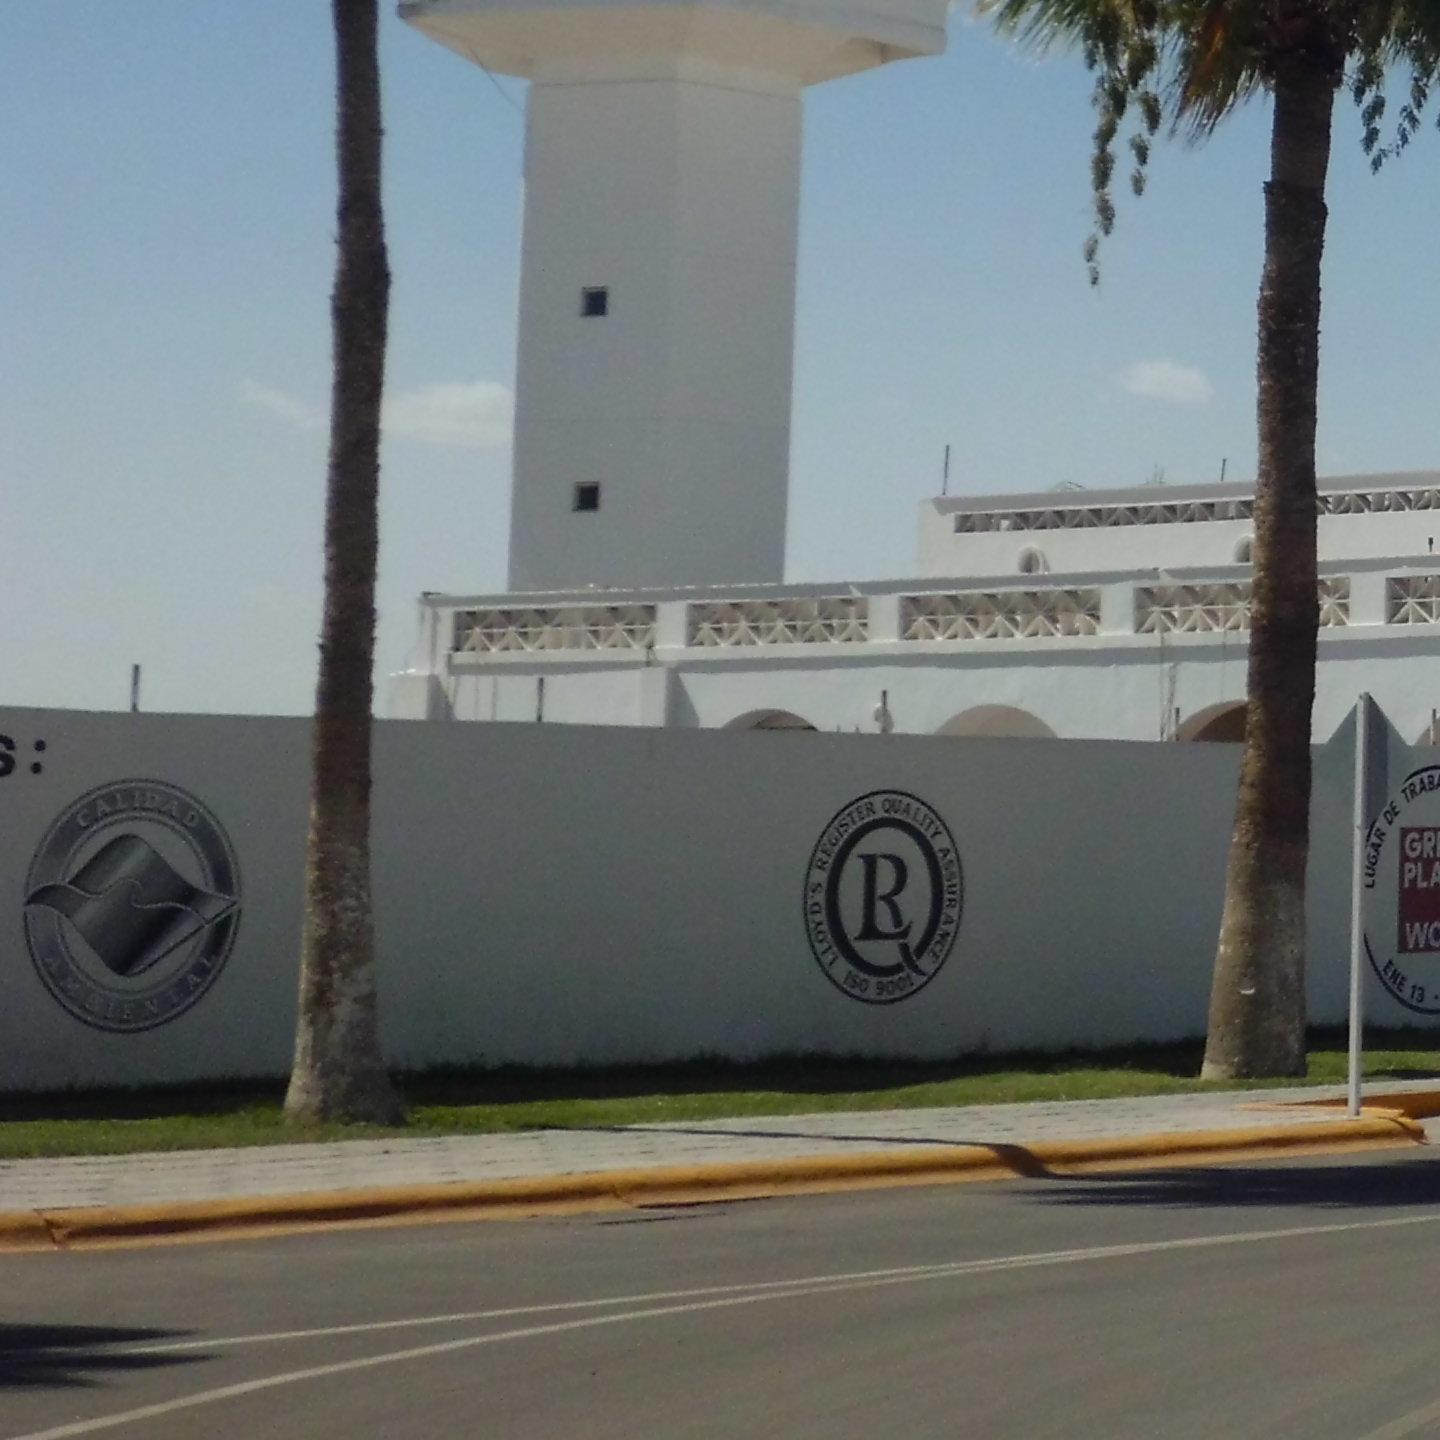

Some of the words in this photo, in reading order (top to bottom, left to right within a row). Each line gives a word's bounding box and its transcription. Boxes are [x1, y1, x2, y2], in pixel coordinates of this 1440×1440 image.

[815, 800, 877, 872] REGISTER
[881, 797, 943, 841] QUALITY
[1364, 830, 1387, 889] LUGAR
[1383, 800, 1401, 827] DE
[1409, 983, 1426, 1003] 13
